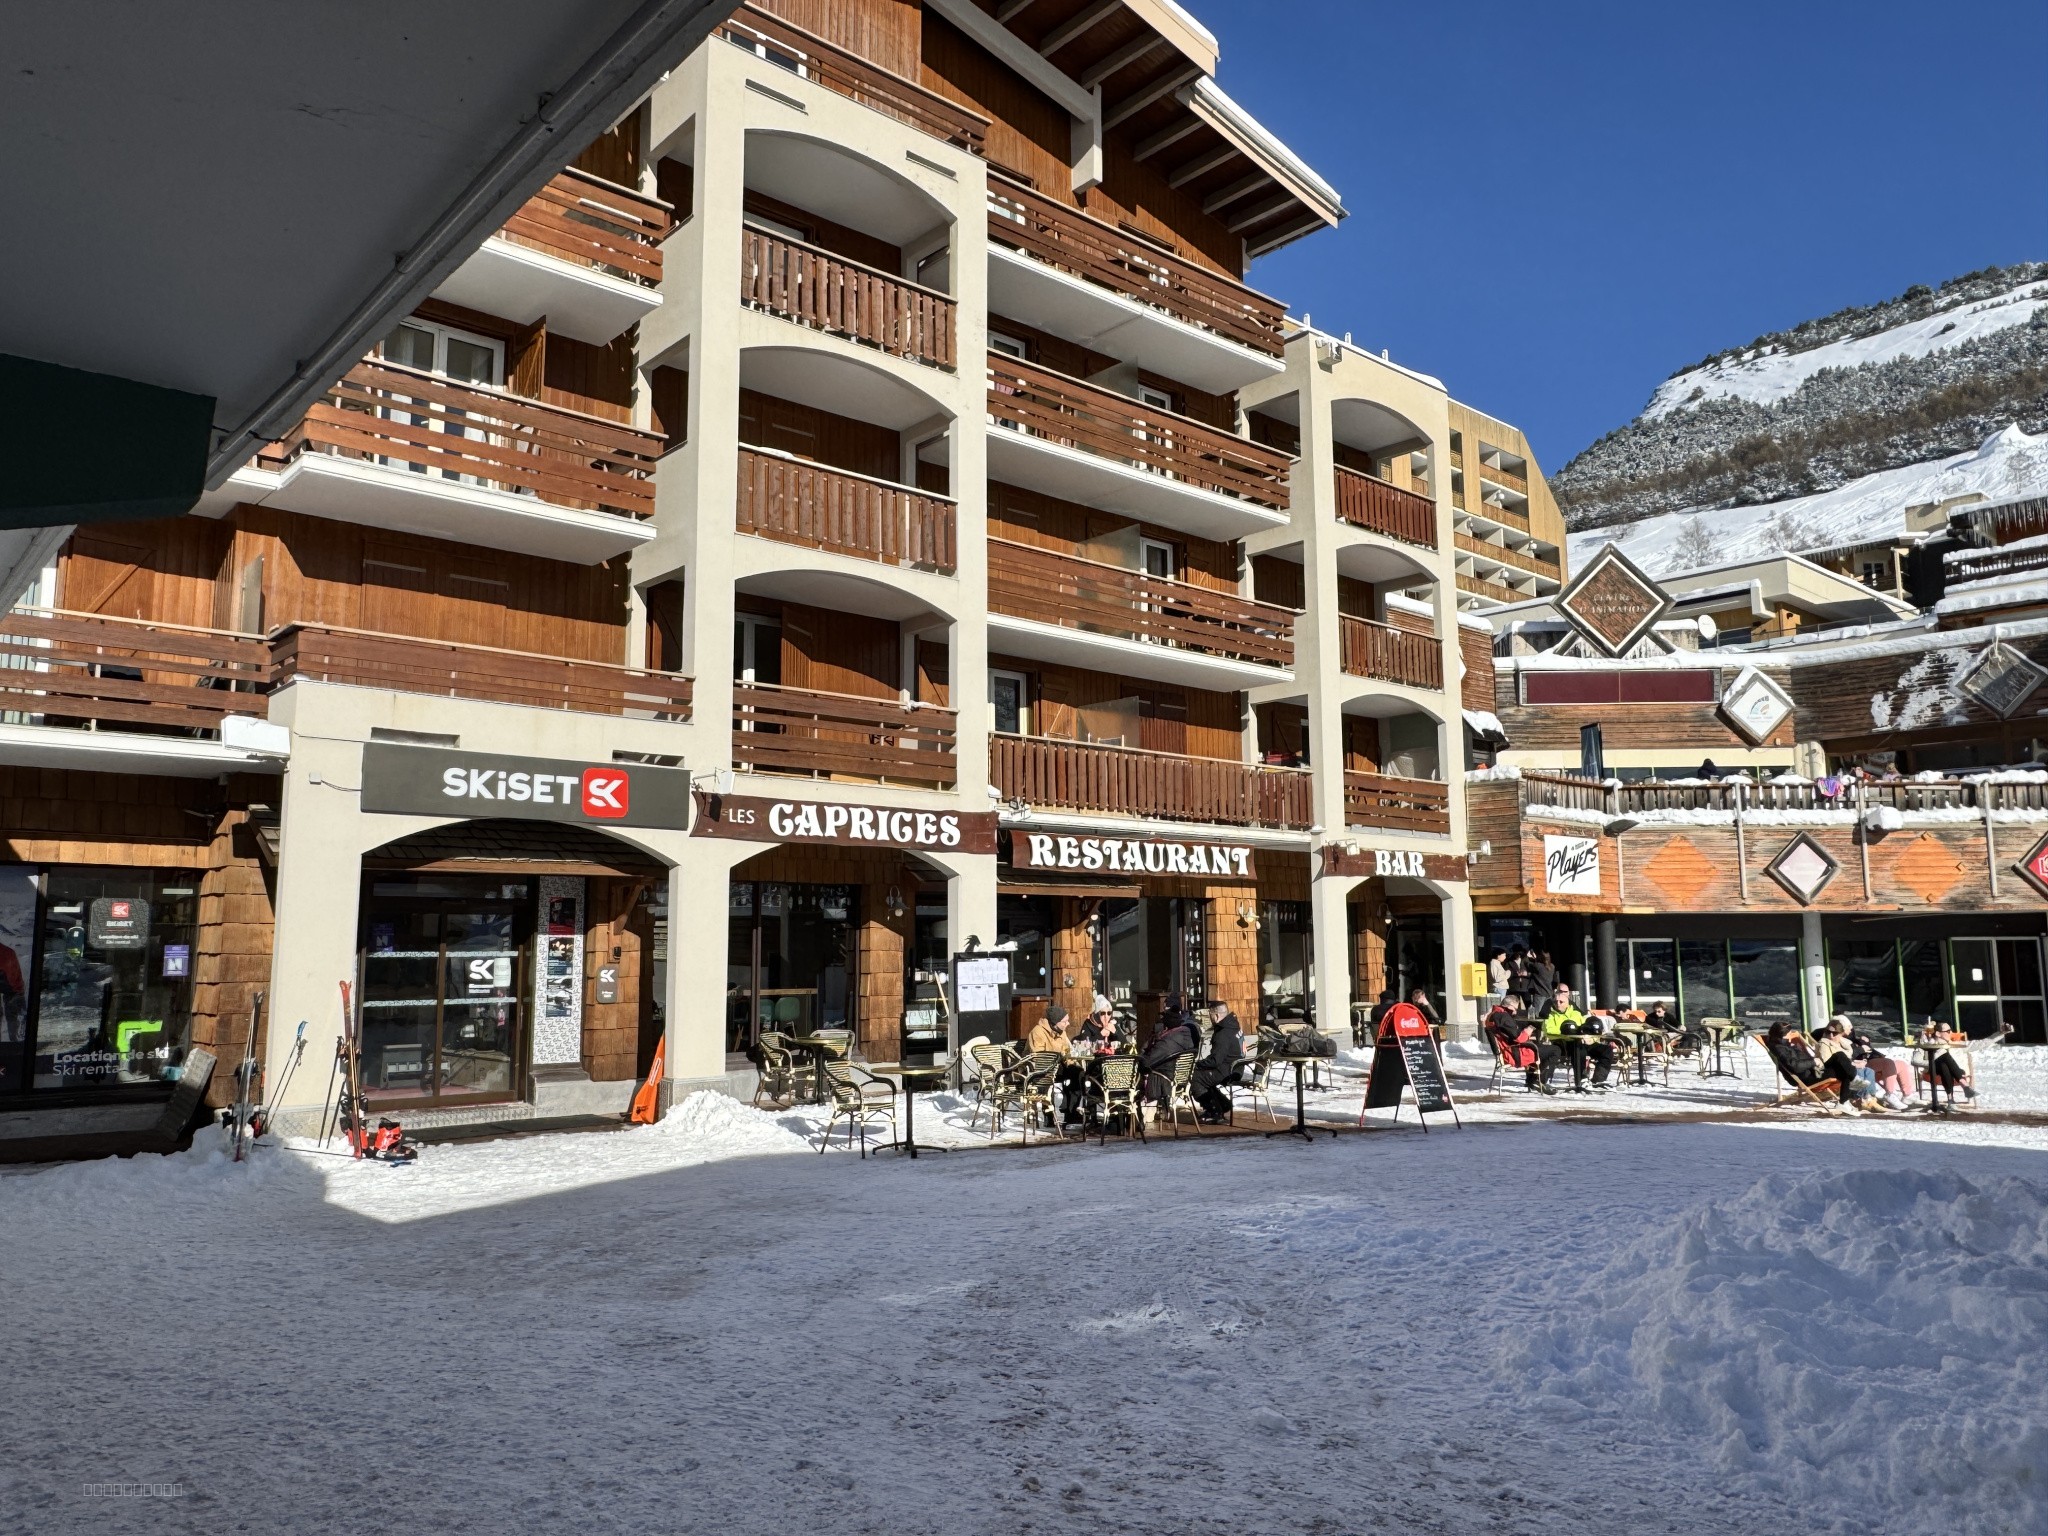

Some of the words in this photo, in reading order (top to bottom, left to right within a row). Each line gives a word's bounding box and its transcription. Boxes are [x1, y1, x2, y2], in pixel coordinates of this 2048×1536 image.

[728, 809, 755, 825] LES
[768, 803, 961, 846] CAPRICES
[1028, 834, 1250, 876] RESTAURANT
[1374, 849, 1426, 878] BAR
[52, 1064, 76, 1076] Ski
[80, 1064, 123, 1075] renta
[53, 1049, 121, 1064] Location
[129, 1050, 144, 1060] de
[147, 1047, 169, 1059] ski
